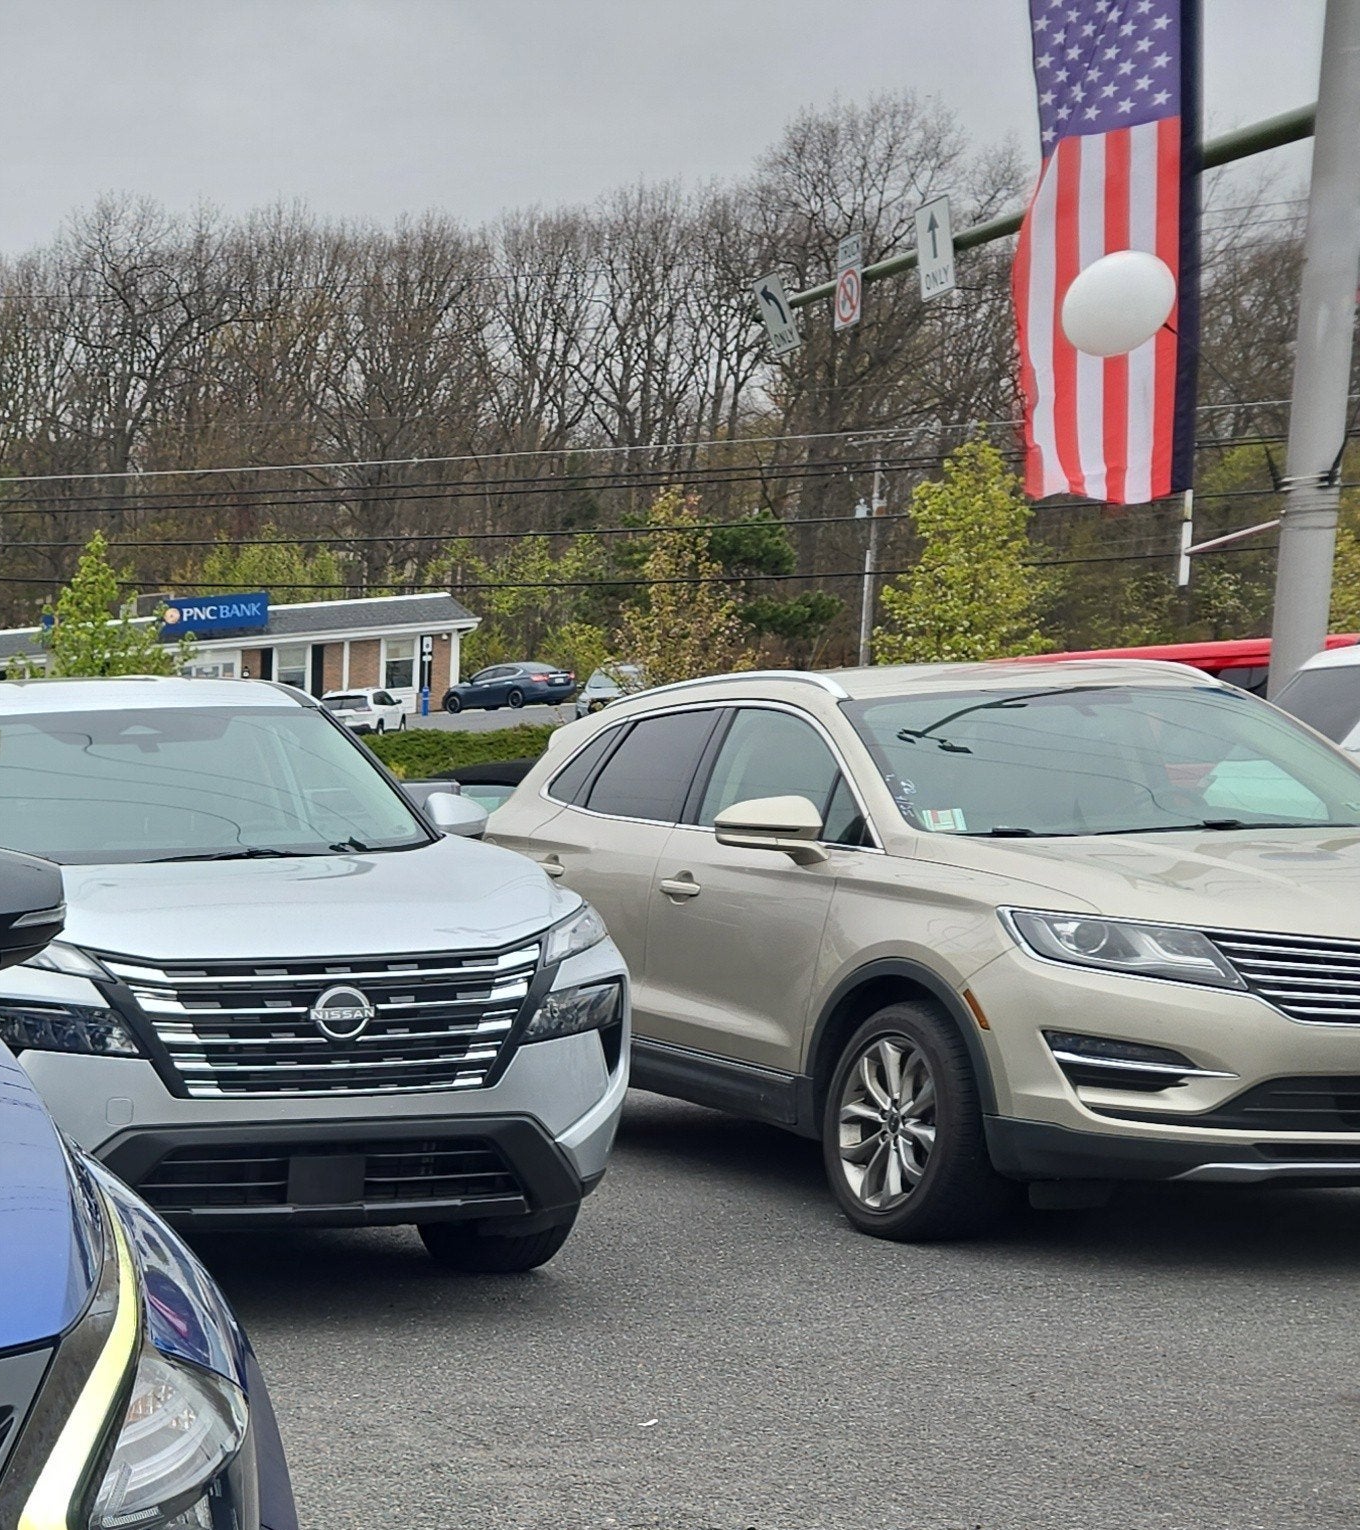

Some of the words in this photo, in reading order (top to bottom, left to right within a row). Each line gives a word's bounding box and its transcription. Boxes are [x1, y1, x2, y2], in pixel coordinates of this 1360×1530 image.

[924, 265, 950, 290] ONLY
[773, 328, 797, 348] ONLY
[182, 606, 217, 622] PNC
[218, 602, 261, 619] BANK
[312, 1008, 375, 1020] NISSAN
